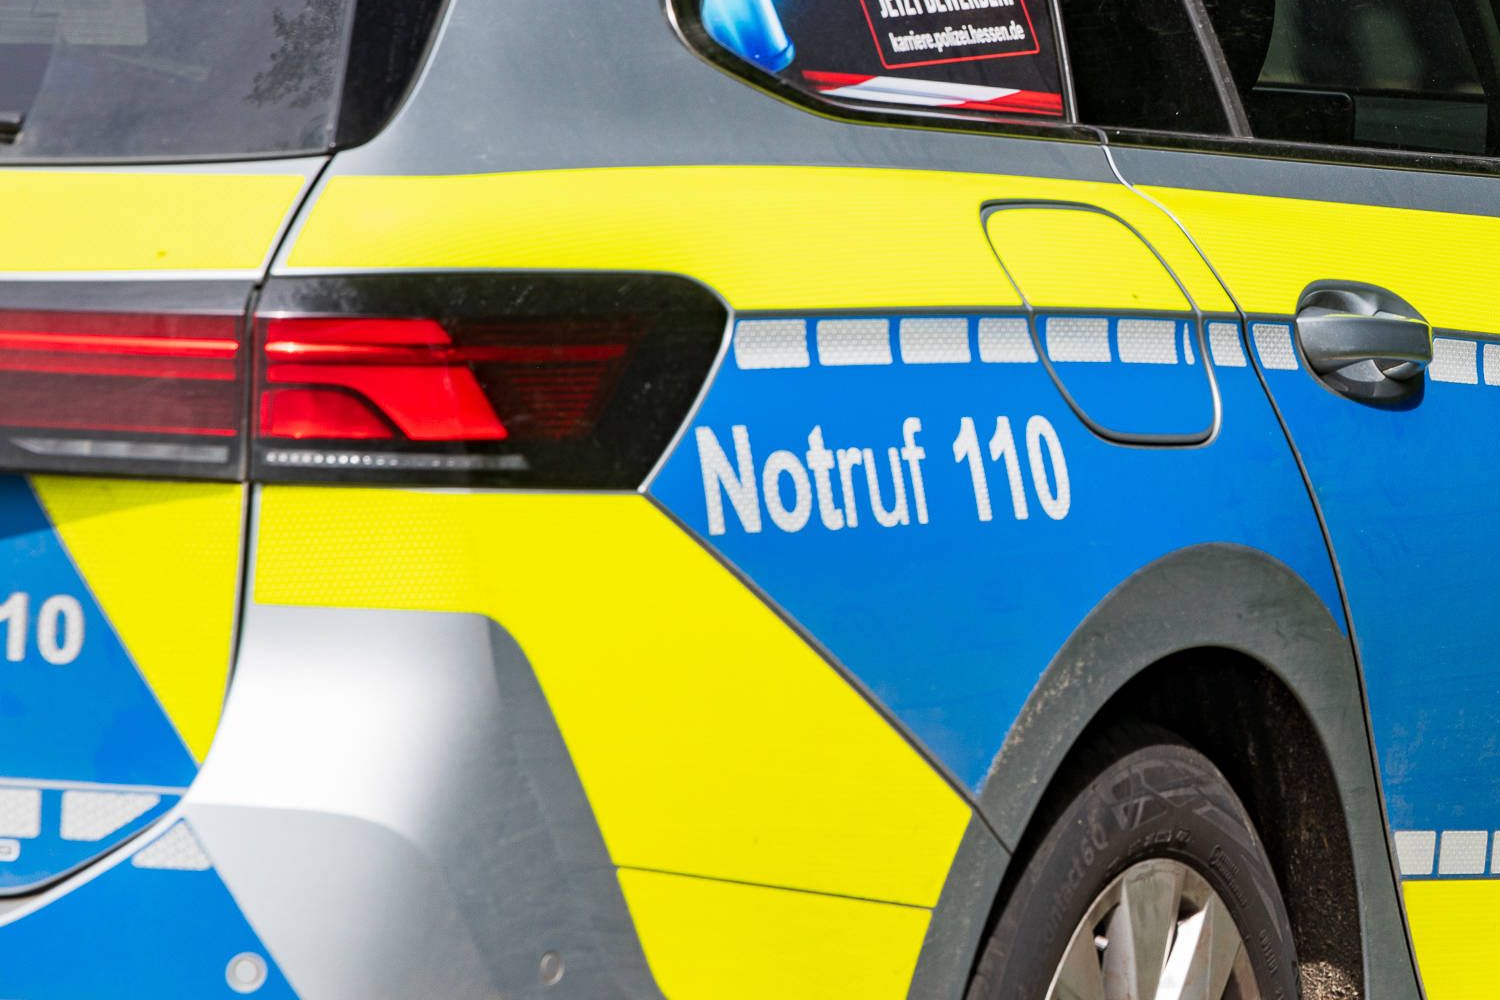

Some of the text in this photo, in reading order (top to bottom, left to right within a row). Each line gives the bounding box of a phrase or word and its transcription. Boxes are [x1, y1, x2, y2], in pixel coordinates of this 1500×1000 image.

[888, 19, 1026, 53] karriere.polizei.hessen.de
[694, 414, 1072, 536] Notruf 110
